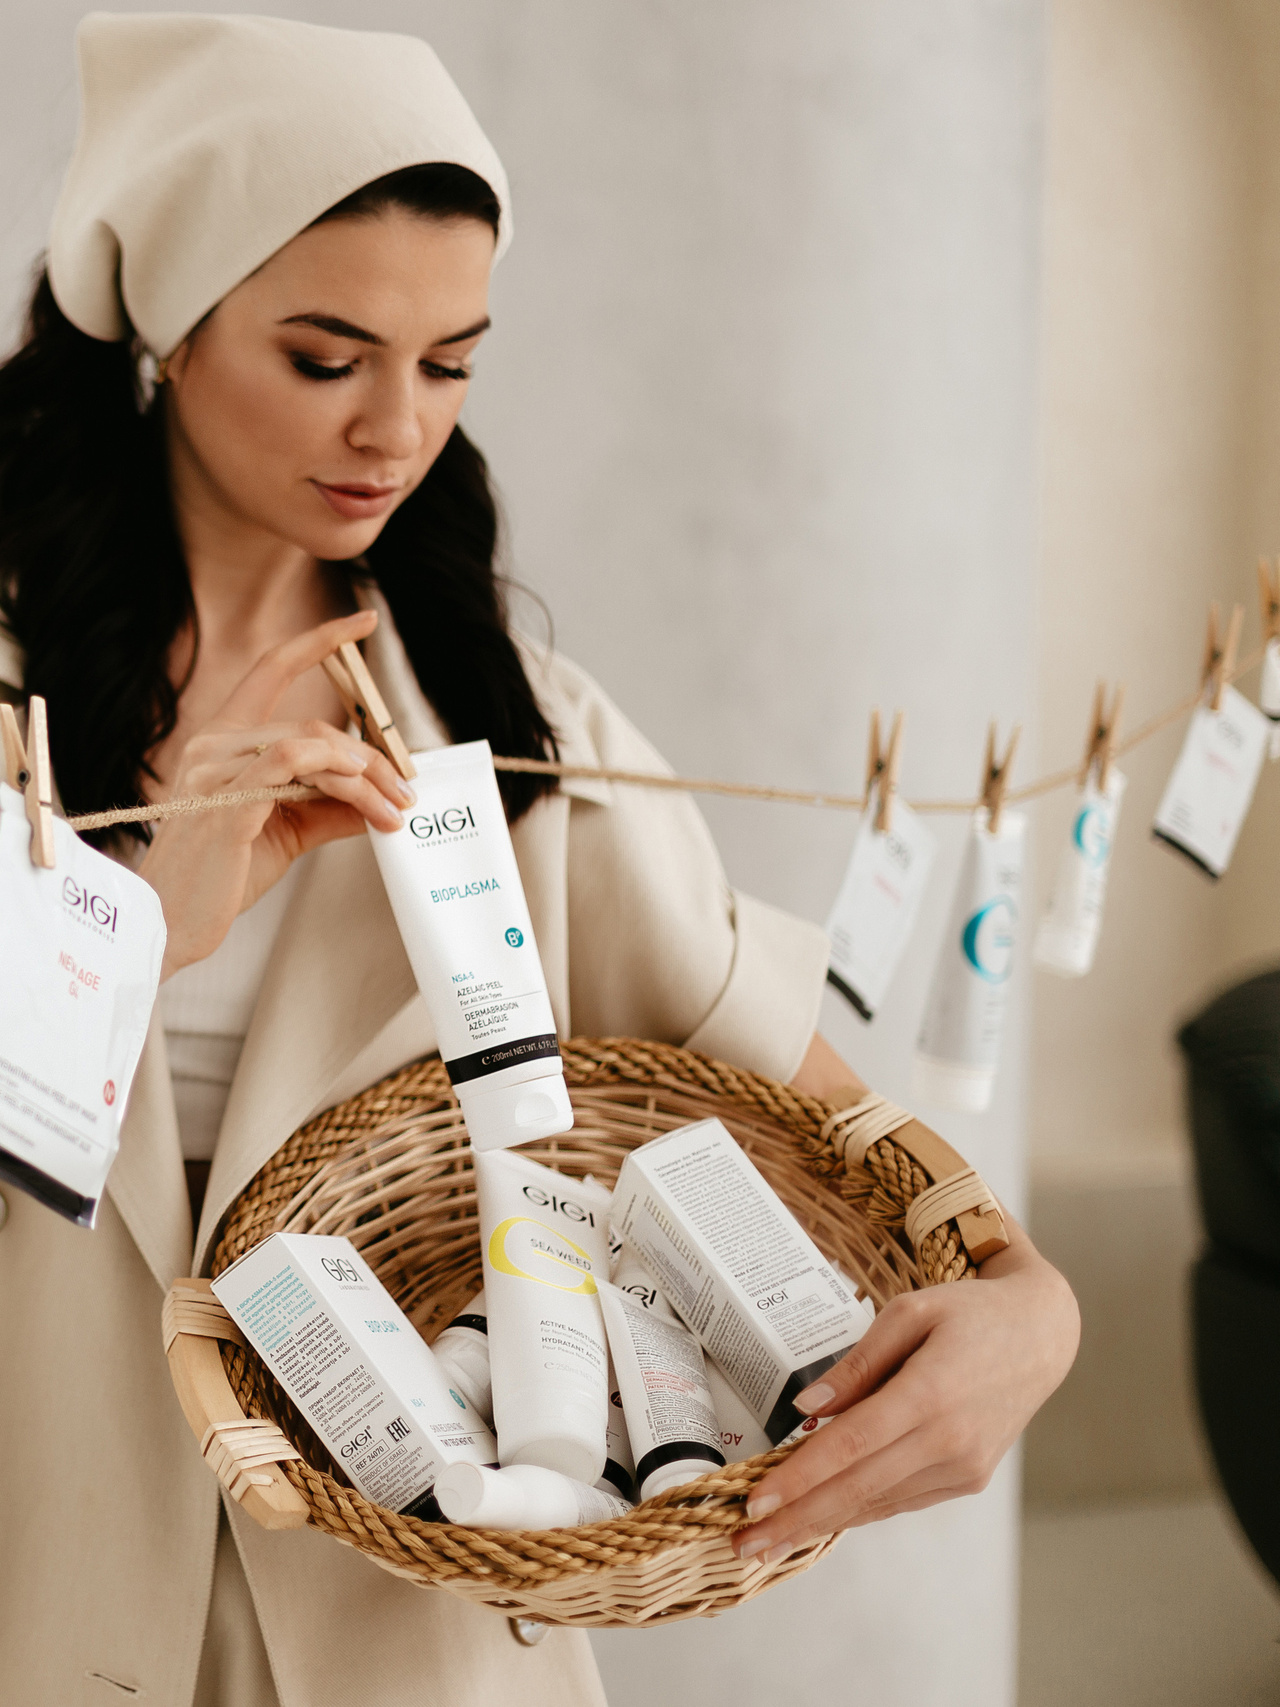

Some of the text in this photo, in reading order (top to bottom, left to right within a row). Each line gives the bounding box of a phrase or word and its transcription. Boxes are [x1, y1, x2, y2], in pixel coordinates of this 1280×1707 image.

[410, 806, 475, 839] GIGI
[417, 831, 479, 849] LABORATORIES
[430, 878, 501, 903] BIOPLASMA
[63, 877, 117, 932] GIGI
[77, 967, 101, 991] AGE
[451, 971, 475, 984] NSA-5
[457, 981, 503, 997] AZELAIC PEEL
[470, 995, 478, 1003] All
[479, 993, 490, 1001] Skin
[465, 1002, 519, 1021] DERMABRASION
[469, 1014, 509, 1031] AZÉLAÏQUE
[471, 1026, 507, 1040] Toutes Peaux
[492, 1049, 513, 1063] 200ml
[523, 1186, 595, 1228] GIGI
[321, 1257, 364, 1282] GIGI
[756, 1290, 788, 1310] GIGI
[769, 1305, 791, 1322] PRODUCT
[798, 1295, 816, 1309] ISRAEL
[364, 1320, 401, 1333] BIOPLASMA
[540, 1320, 566, 1330] ACTIVE
[542, 1337, 584, 1353] HYDRATANT
[340, 1429, 371, 1457] GIGI
[355, 1445, 384, 1471] REF 24070
[361, 1448, 404, 1483] PRODUCT OF ISRAEL
